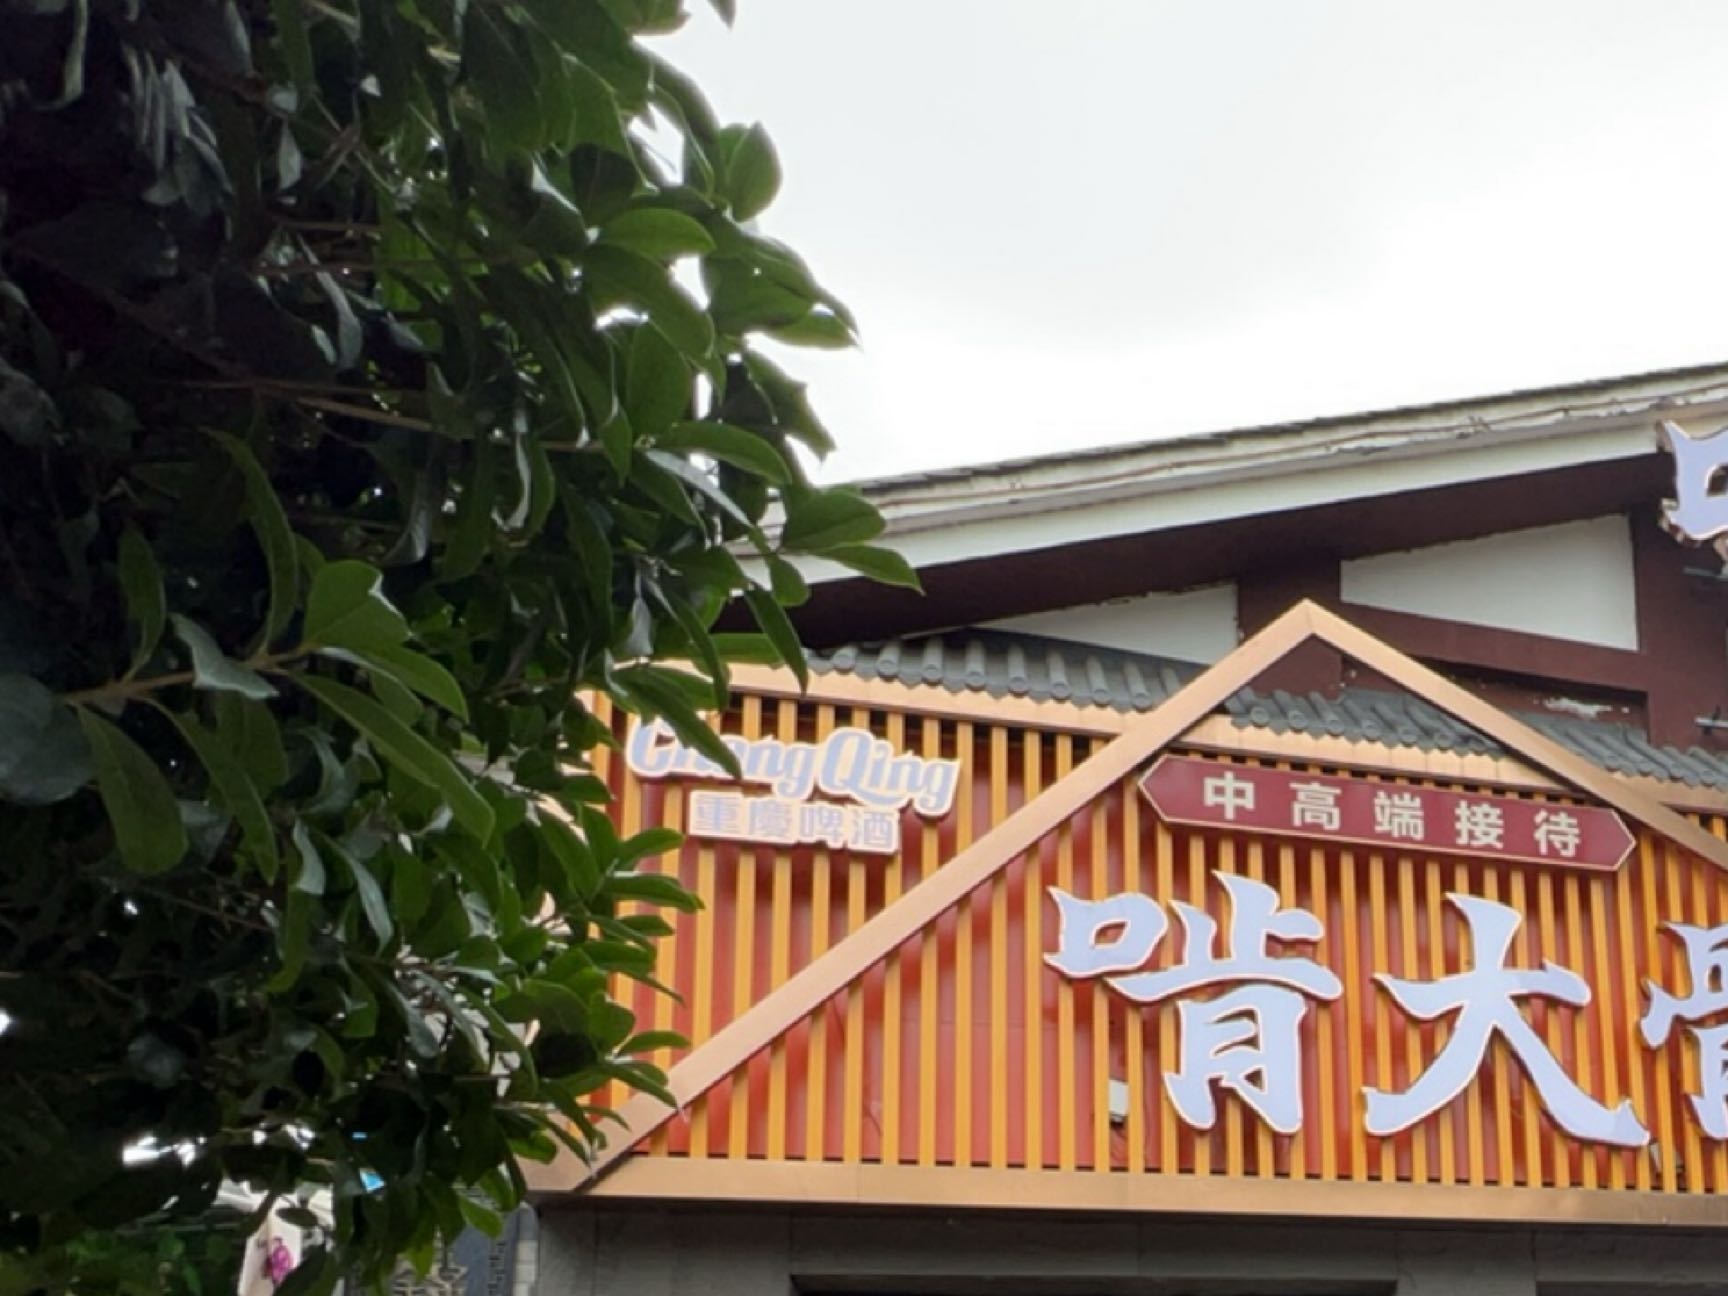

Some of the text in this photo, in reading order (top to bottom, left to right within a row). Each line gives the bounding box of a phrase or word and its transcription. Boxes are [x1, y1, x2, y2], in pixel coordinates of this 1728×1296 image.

[1202, 772, 1582, 858] 中高端接待
